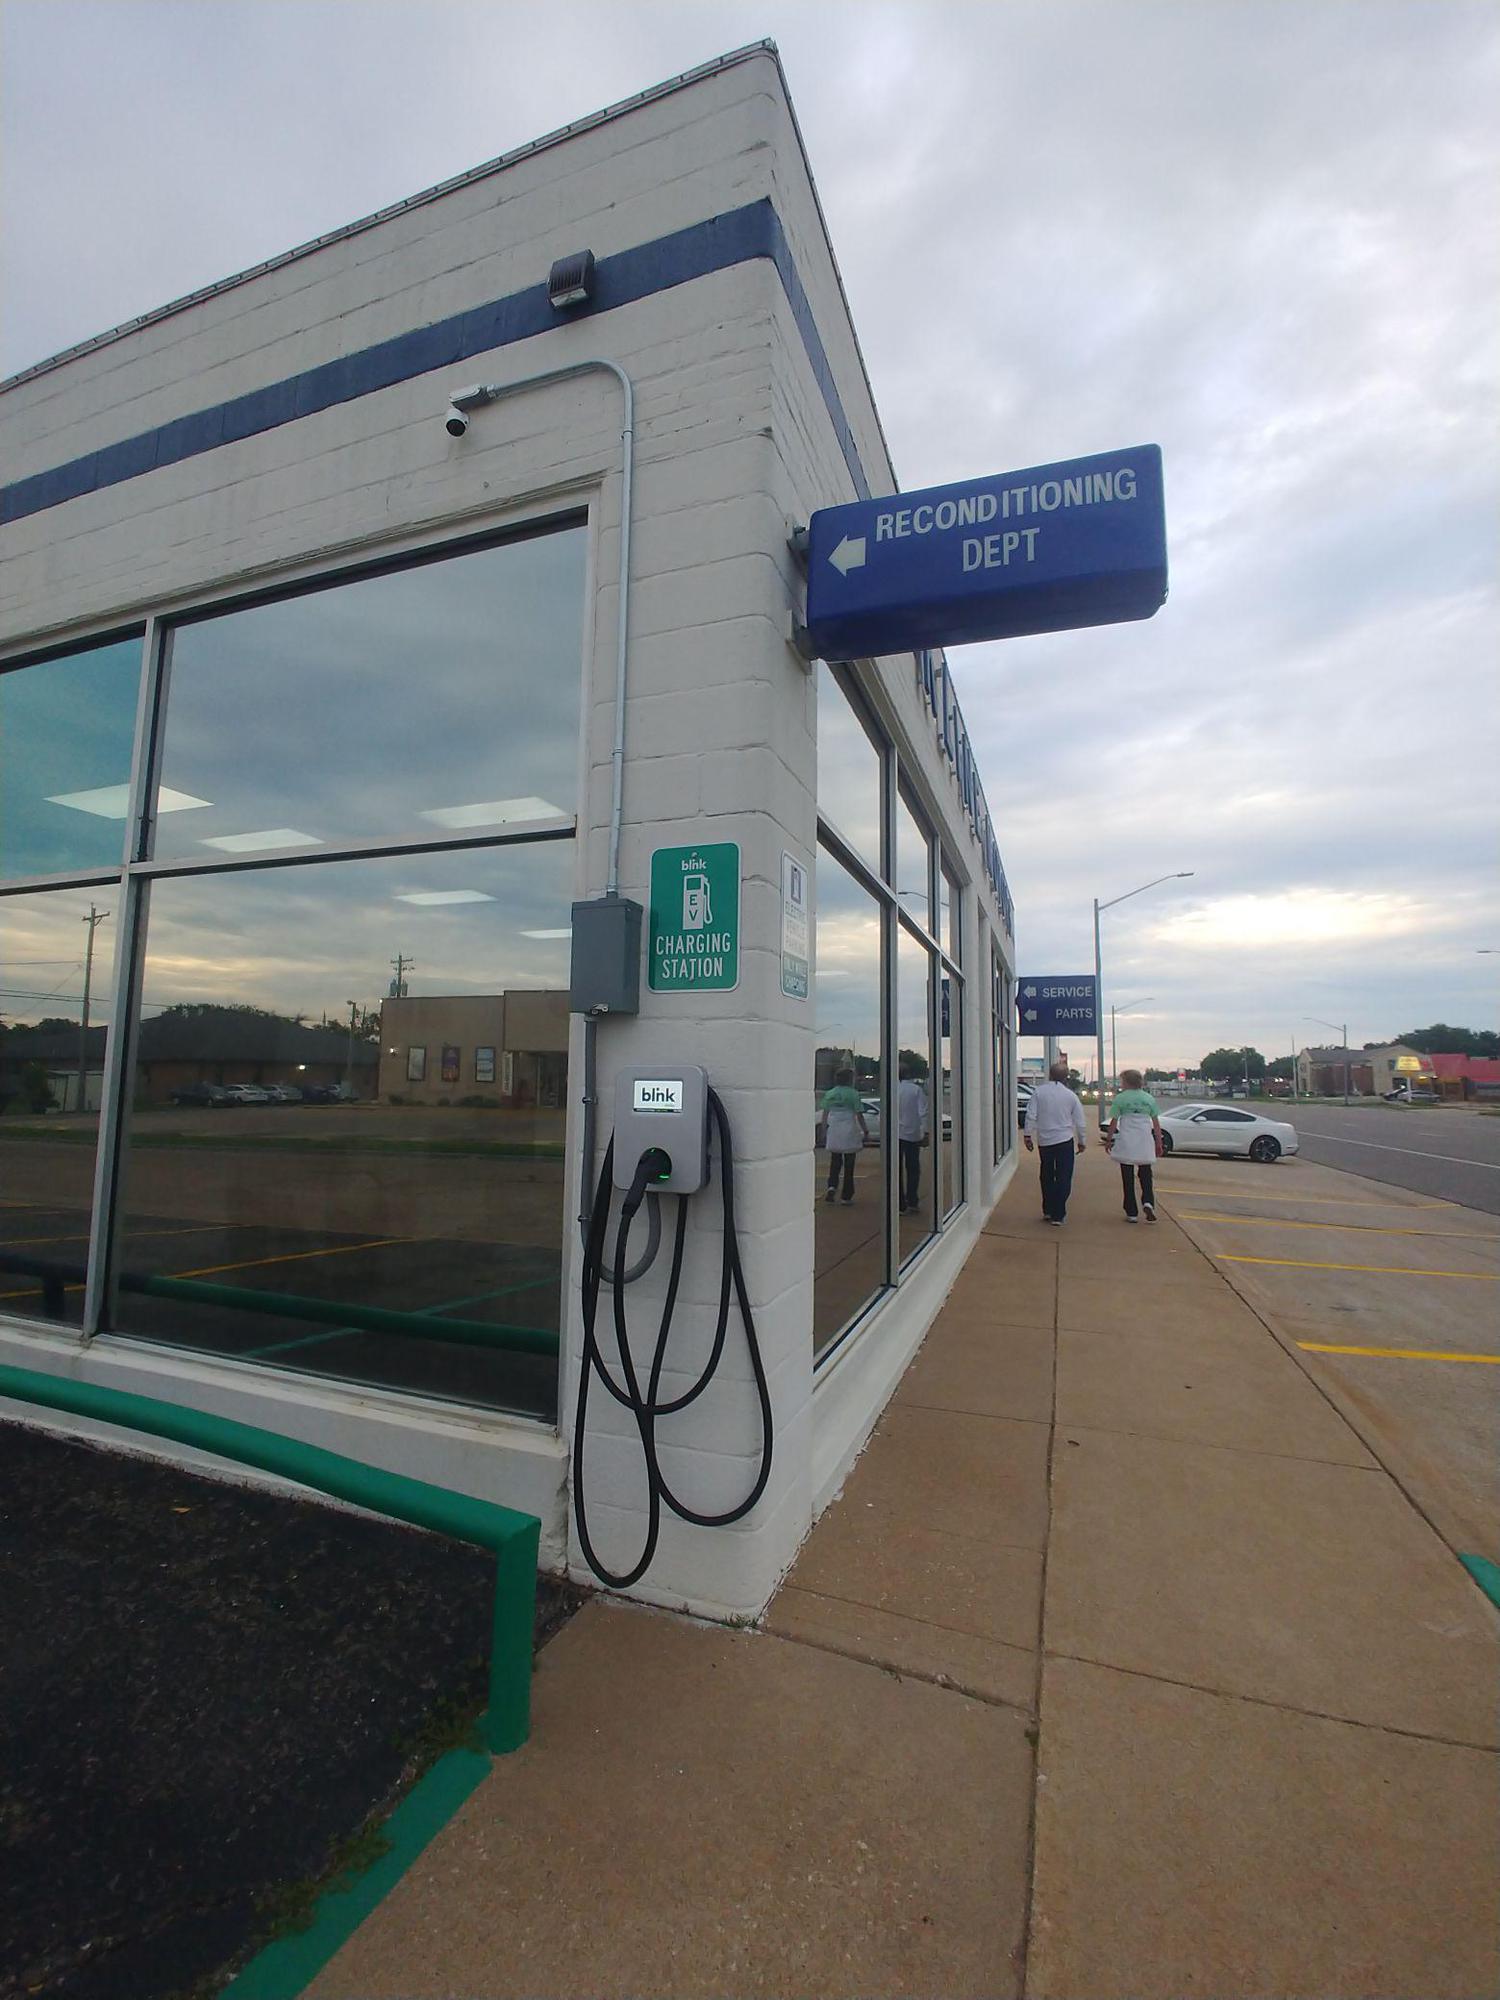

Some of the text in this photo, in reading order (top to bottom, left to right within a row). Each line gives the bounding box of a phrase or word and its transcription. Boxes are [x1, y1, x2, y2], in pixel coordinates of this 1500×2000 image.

[876, 468, 1137, 542] RECONDITIONING
[962, 527, 1040, 572] DEPT
[681, 859, 707, 871] blink
[656, 932, 731, 955] CHARGING
[662, 957, 723, 979] STATION
[1042, 986, 1093, 998] SERVICE
[1055, 1007, 1093, 1019] PARTS
[642, 1087, 676, 1102] blink
